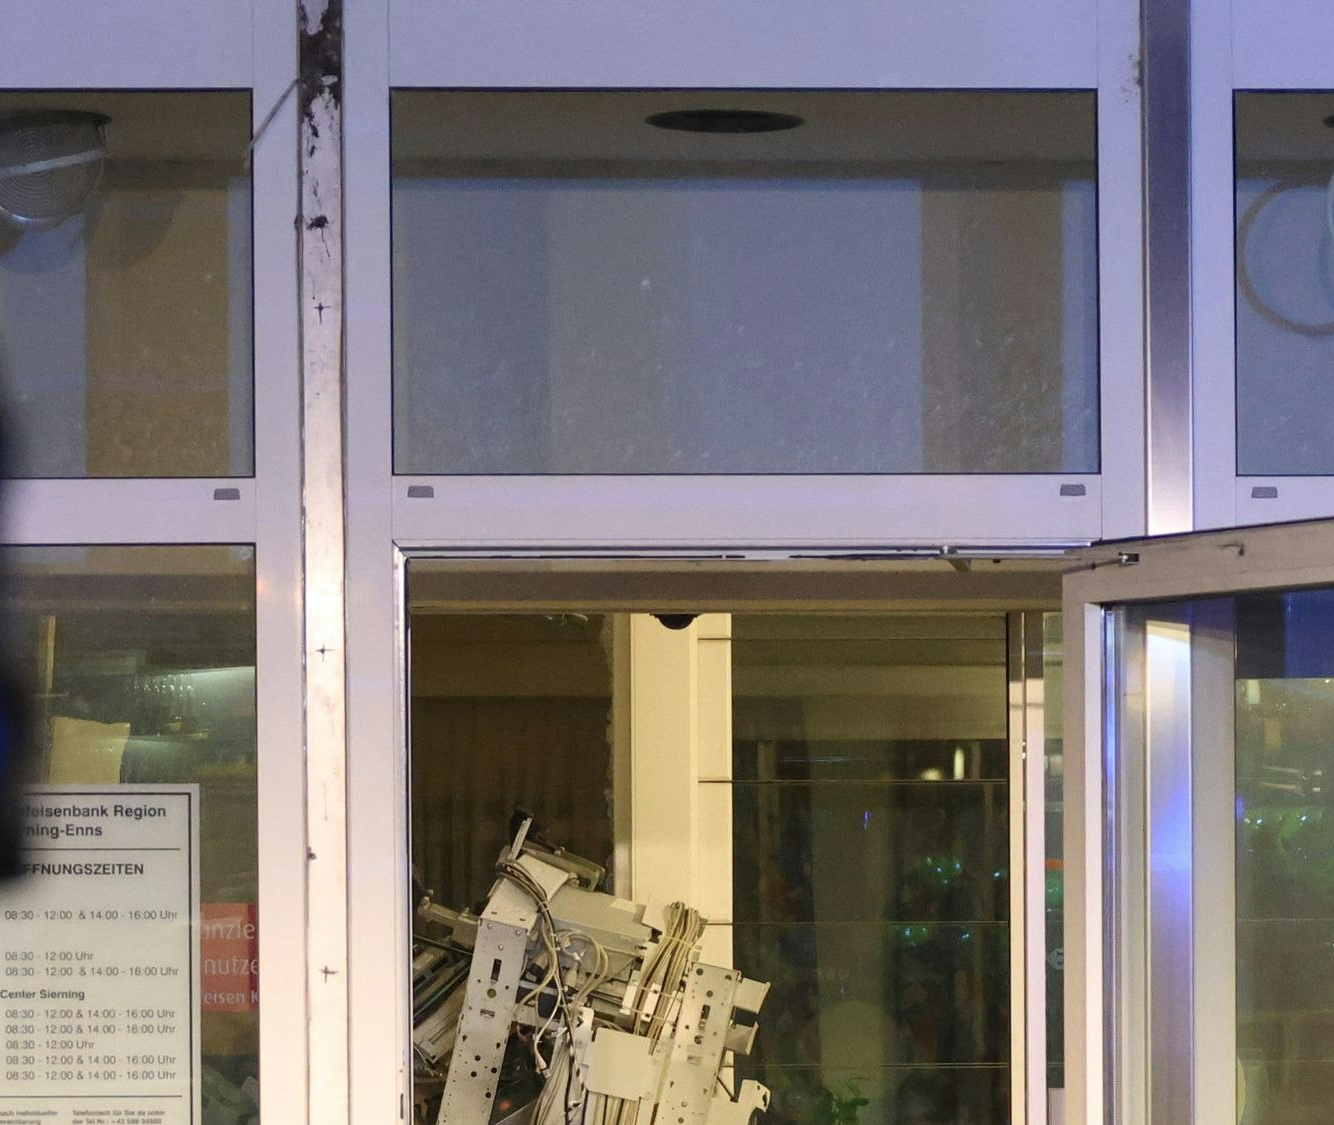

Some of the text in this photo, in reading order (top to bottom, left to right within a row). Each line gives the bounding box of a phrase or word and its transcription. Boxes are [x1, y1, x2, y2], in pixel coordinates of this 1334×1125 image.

[24, 804, 166, 820] feisenbank Region
[25, 824, 103, 839] ning-Enns
[5, 910, 34, 920] 08:30
[45, 910, 73, 920] 12:00
[79, 910, 87, 920] &
[90, 910, 118, 920] 14:00
[129, 910, 157, 920] 16:00
[160, 910, 178, 920] Uhr
[5, 951, 34, 961] 08:30
[45, 951, 73, 961] 12:00
[75, 951, 94, 961] Uhr
[5, 967, 34, 977] 08:30
[45, 967, 73, 977] 12:00
[79, 967, 87, 977] &
[90, 967, 118, 977] 14:00
[129, 967, 157, 977] 16:00
[160, 967, 178, 977] Uhr
[0, 990, 36, 999] Center
[40, 989, 85, 1001] Sierning
[203, 992, 245, 1004] eisen
[5, 1009, 34, 1019] 08:30
[45, 1009, 73, 1019] 12:00
[76, 1009, 83, 1019] &
[88, 1009, 115, 1019] 14:00
[126, 1009, 154, 1019] 16:00
[157, 1009, 175, 1019] Uhr
[5, 1024, 34, 1034] 08:30
[45, 1024, 73, 1034] 12:00
[76, 1024, 83, 1034] &
[88, 1024, 115, 1034] 14:00
[126, 1024, 154, 1034] 16:00
[157, 1024, 175, 1034] Uhr
[5, 1040, 34, 1050] 08:30
[45, 1040, 73, 1050] 12:00
[75, 1040, 94, 1050] Uhr
[6, 1055, 35, 1065] 08:30
[46, 1055, 74, 1065] 12:00
[77, 1055, 84, 1065] &
[89, 1055, 116, 1065] 14:00
[127, 1055, 155, 1065] 16:00
[158, 1055, 176, 1065] Uhr
[6, 1071, 35, 1081] 08:30
[46, 1071, 74, 1081] 12:00
[77, 1071, 84, 1081] &
[89, 1071, 116, 1081] 14:00
[127, 1071, 155, 1081] 16:00
[158, 1071, 176, 1081] Uhr
